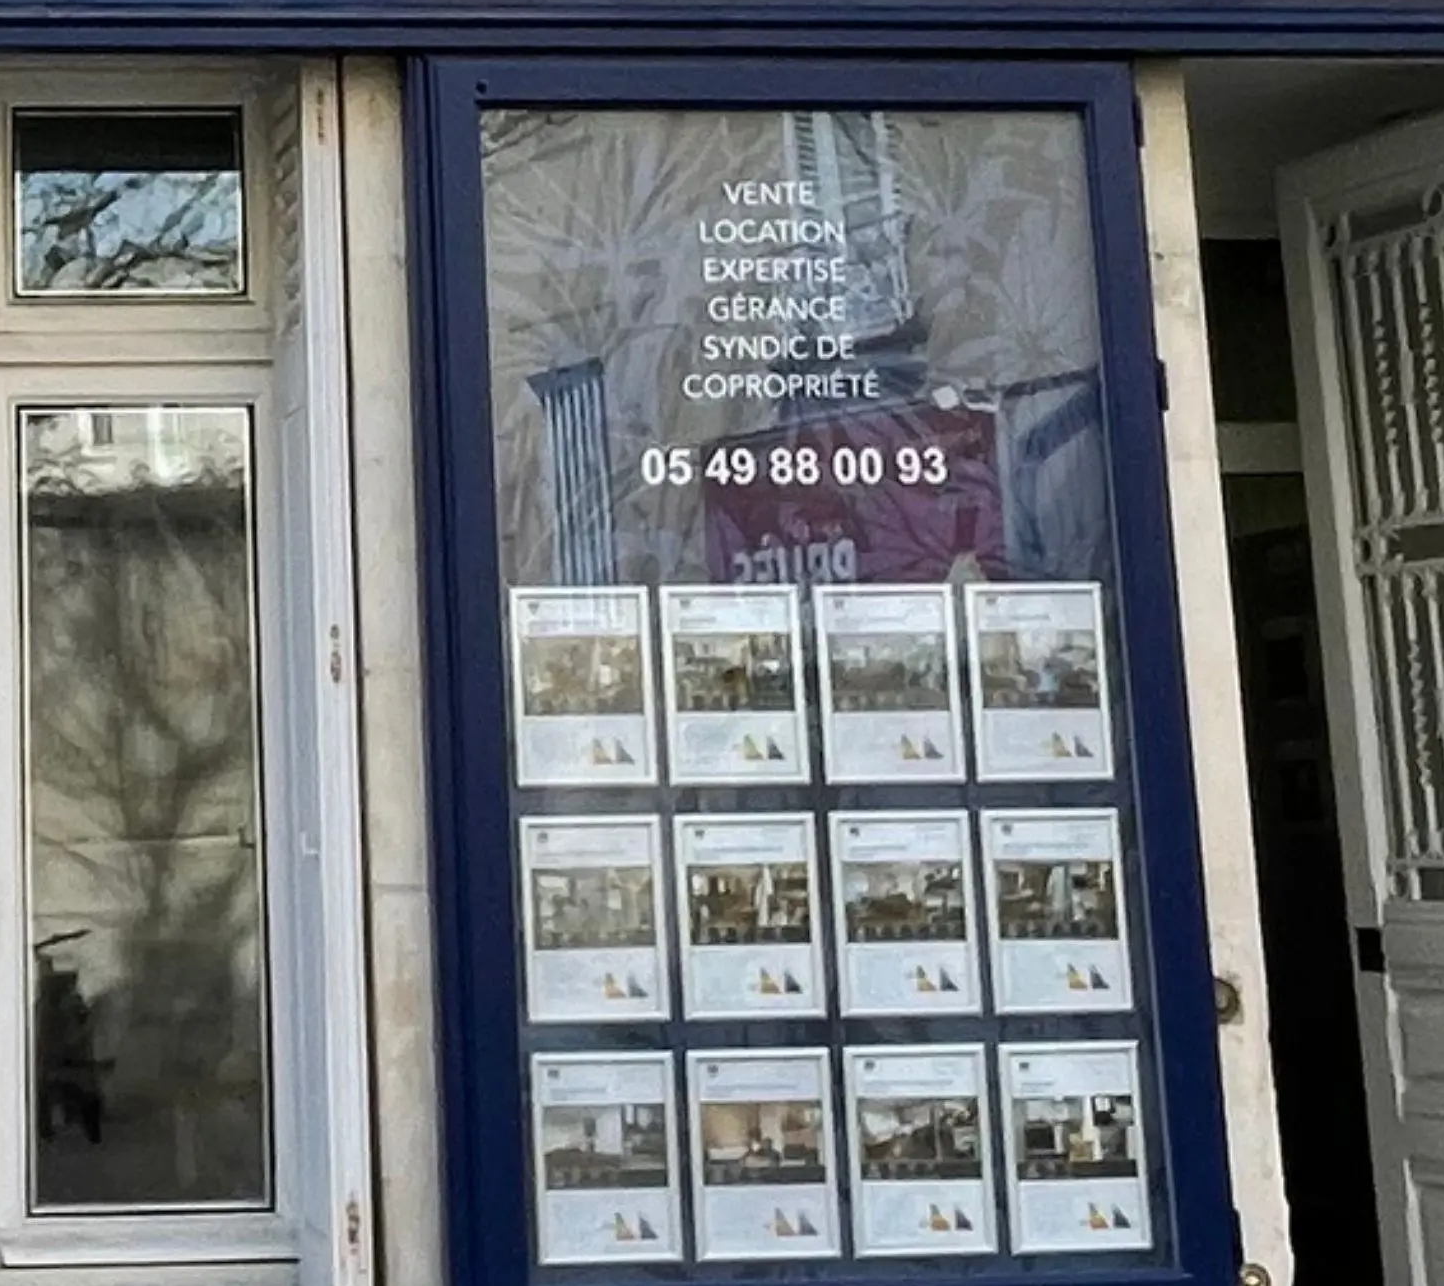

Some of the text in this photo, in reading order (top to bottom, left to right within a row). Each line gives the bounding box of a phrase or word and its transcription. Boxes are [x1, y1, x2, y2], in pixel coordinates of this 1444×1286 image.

[723, 181, 815, 206] VENTE
[699, 219, 845, 244] LOCATION
[703, 257, 846, 283] EXPERTISE
[709, 292, 846, 322] GÉRANCE
[703, 334, 855, 360] SYNDIC DE
[682, 367, 880, 399] COPROPRIÉTÉ
[641, 447, 948, 486] 05 49 88 00 93
